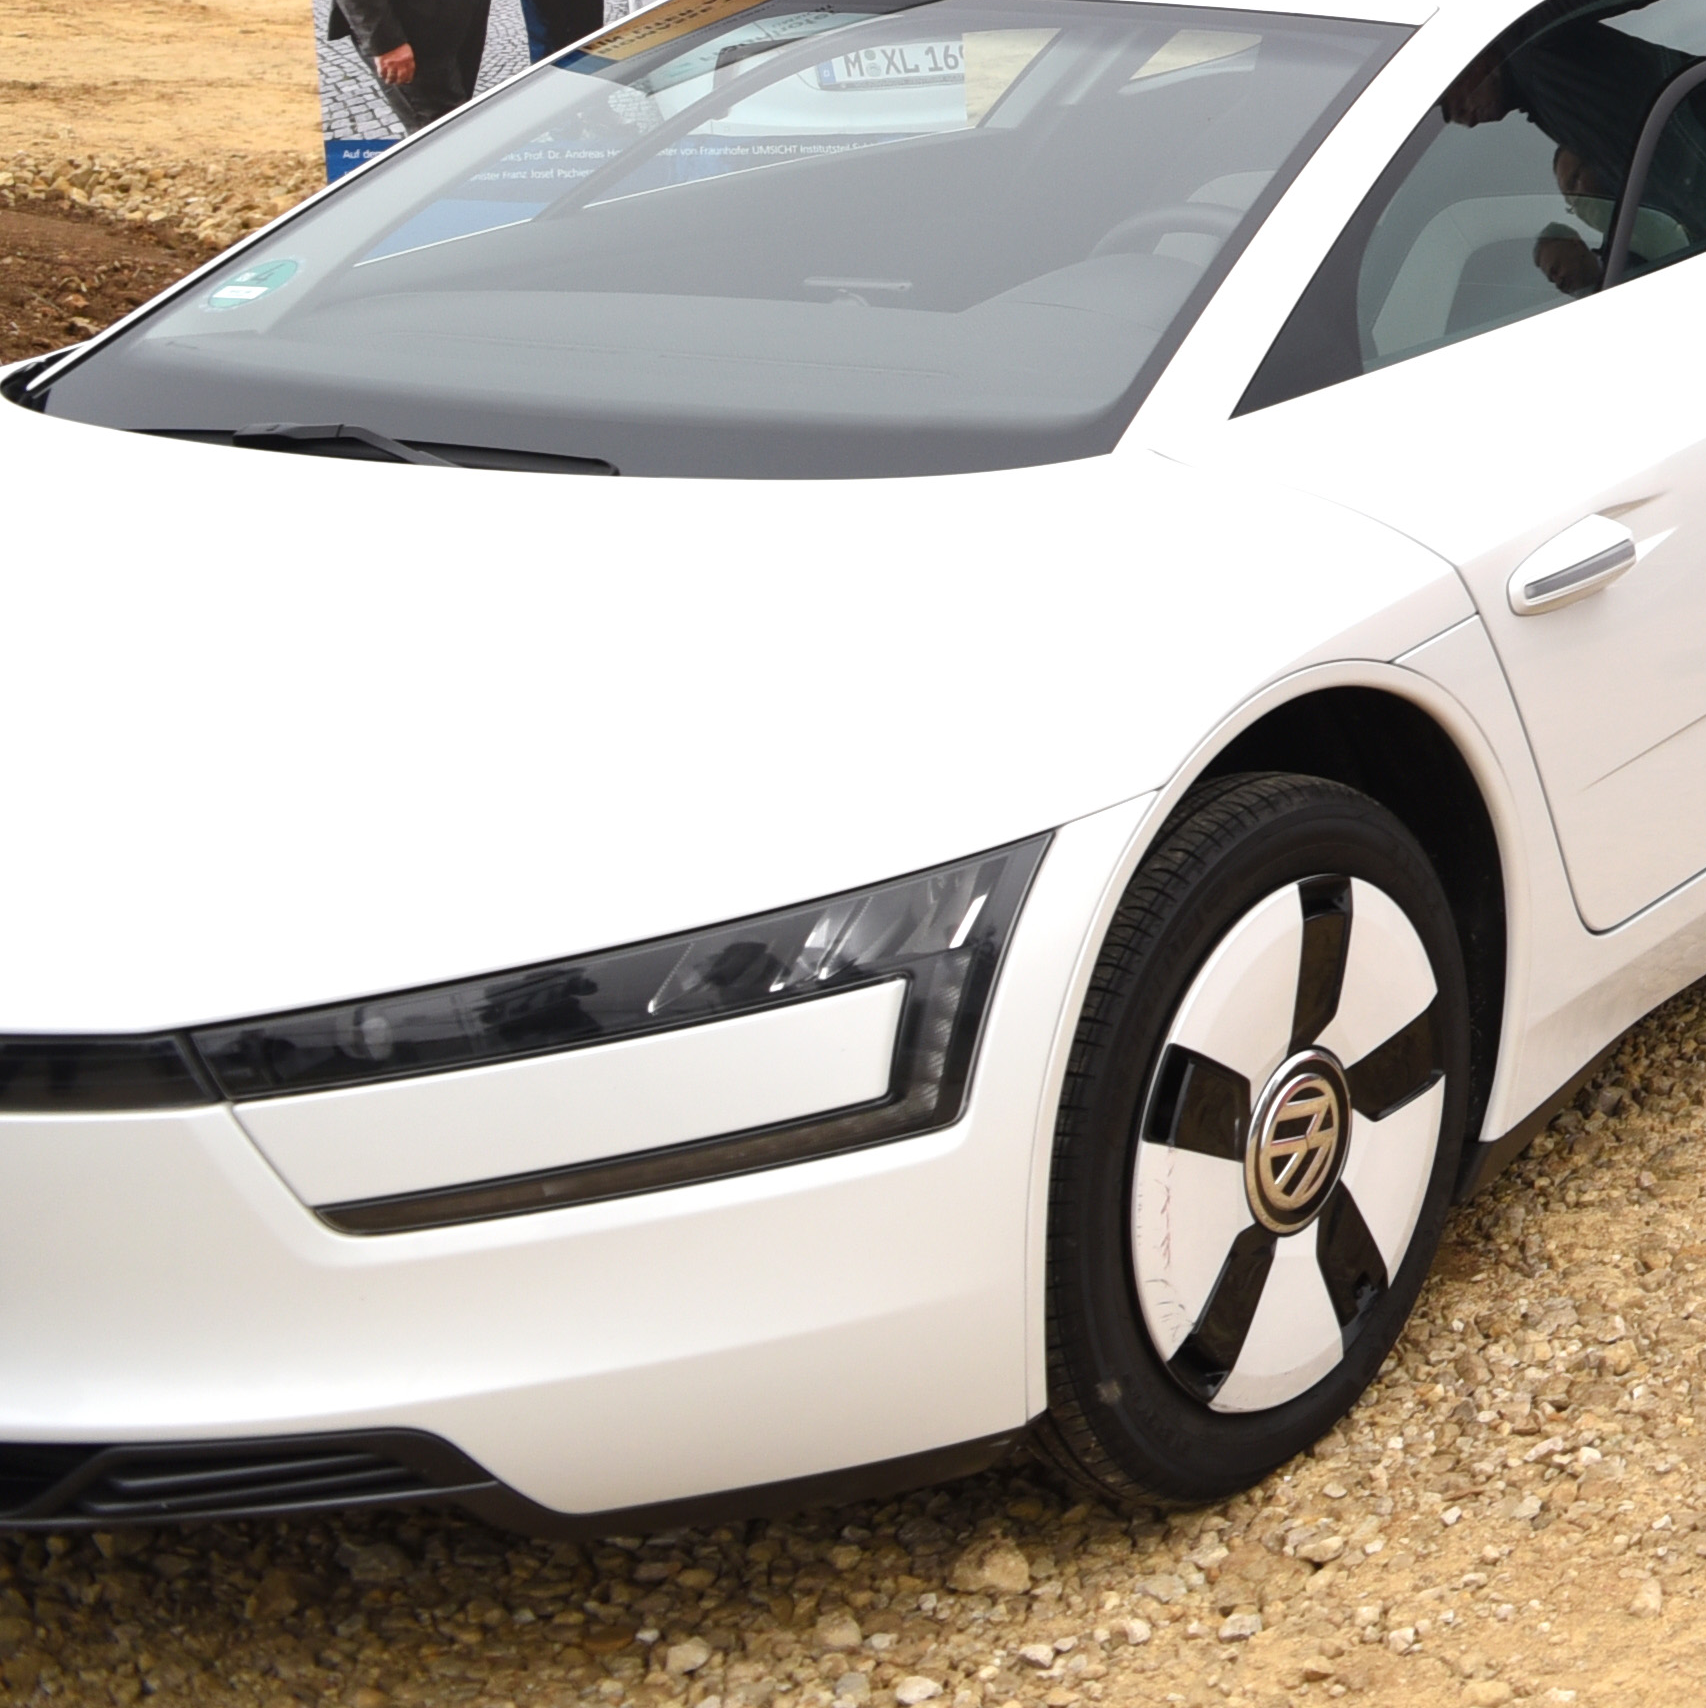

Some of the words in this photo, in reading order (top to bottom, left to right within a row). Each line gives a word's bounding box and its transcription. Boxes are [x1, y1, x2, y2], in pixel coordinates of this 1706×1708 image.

[880, 48, 920, 75] XL
[342, 149, 361, 159] Auf
[565, 148, 605, 159] Andreas
[680, 146, 698, 156] von
[699, 145, 750, 157] Fraunhofer
[752, 144, 798, 156] UMSICHT
